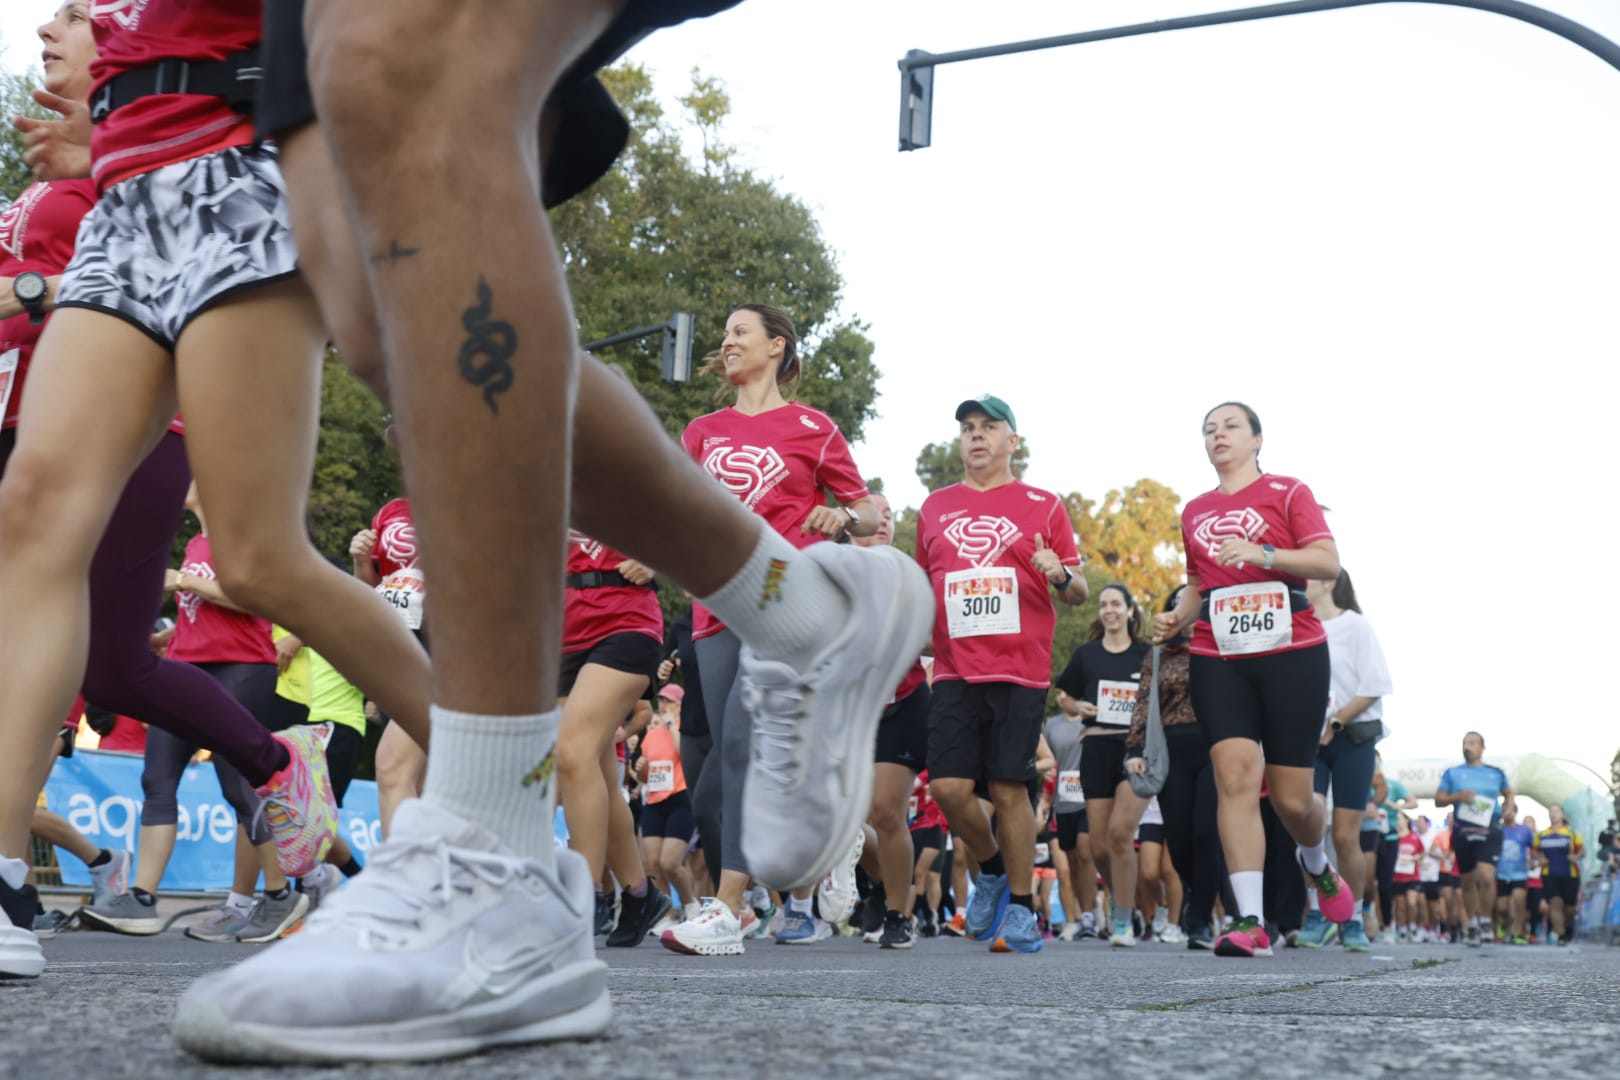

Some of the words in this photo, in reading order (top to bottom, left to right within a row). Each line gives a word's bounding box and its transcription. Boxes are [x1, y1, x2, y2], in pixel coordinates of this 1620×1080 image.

[381, 590, 410, 608] 543
[962, 595, 1001, 617] 3010
[1229, 611, 1274, 635] 2646
